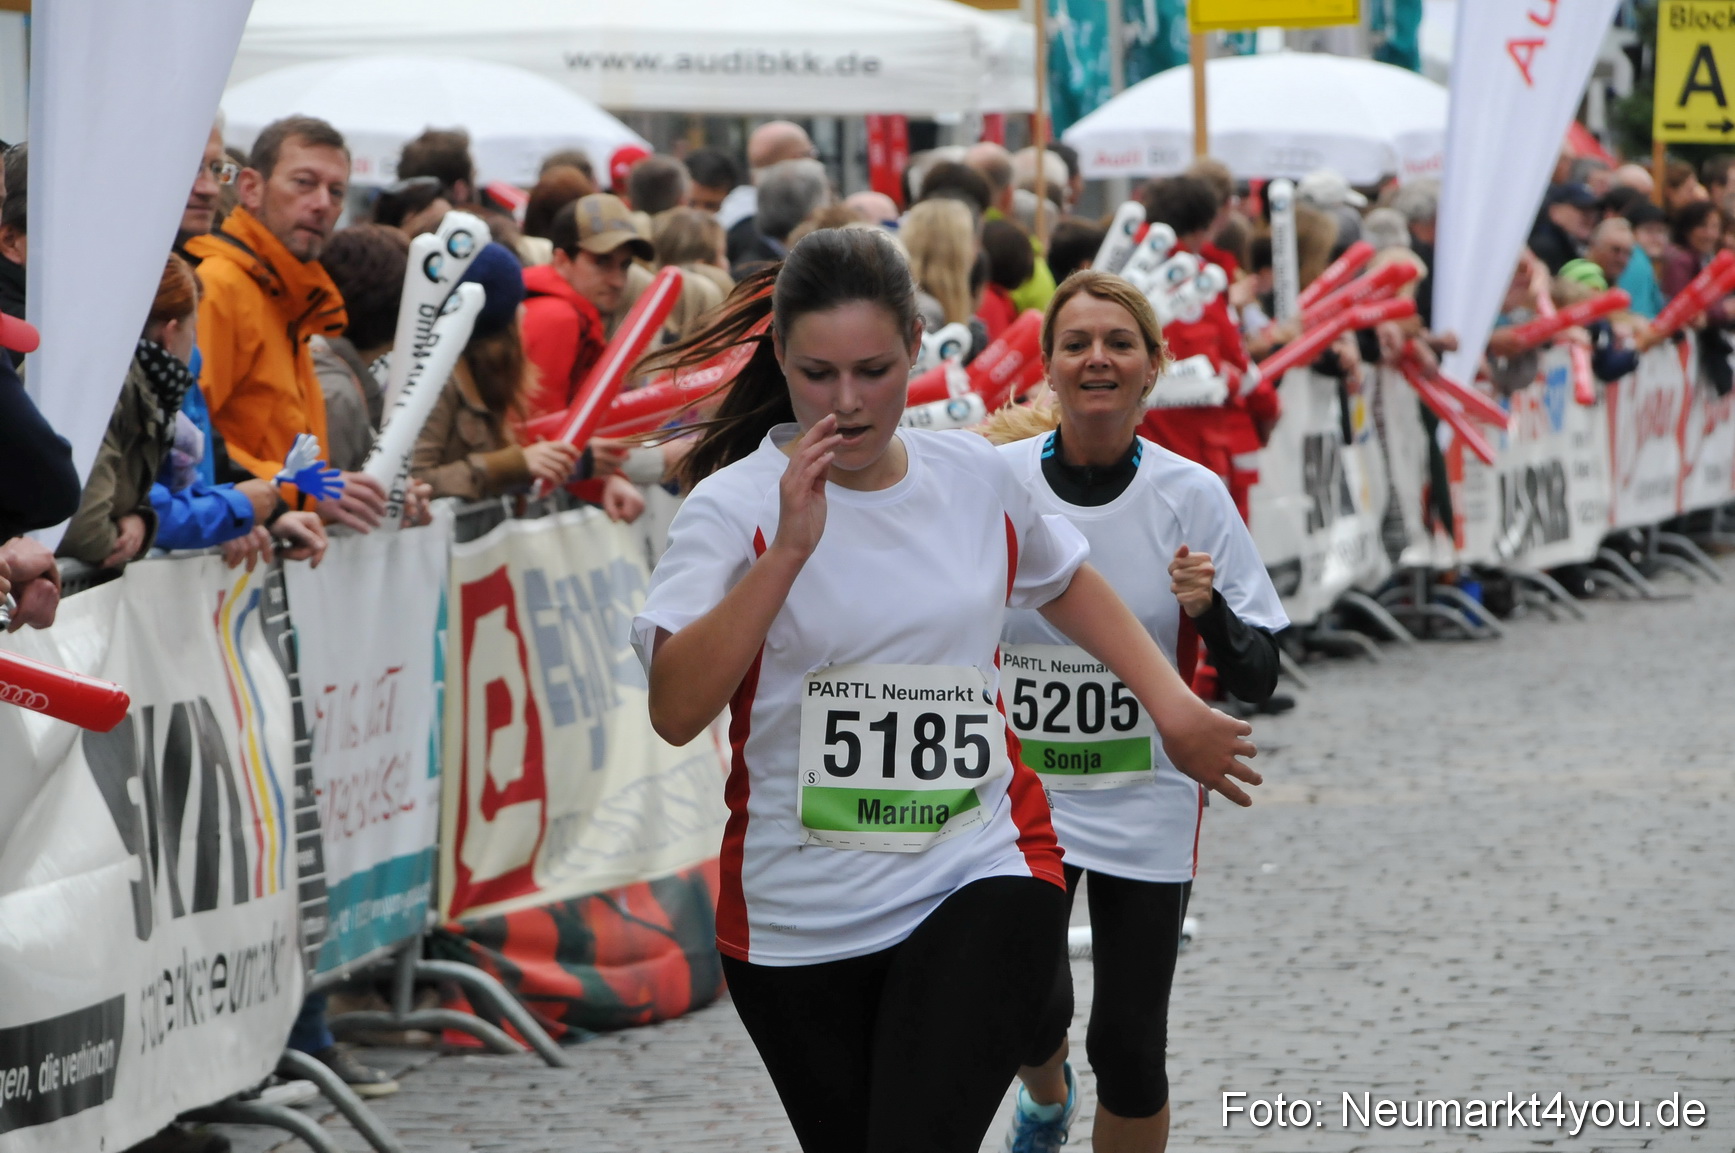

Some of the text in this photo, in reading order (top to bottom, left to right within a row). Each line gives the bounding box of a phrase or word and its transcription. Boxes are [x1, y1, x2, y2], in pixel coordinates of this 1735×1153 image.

[563, 48, 881, 78] www.audibkk.de
[1679, 43, 1727, 107] A
[1003, 653, 1047, 673] PARTL
[808, 681, 974, 702] PARTL Neumarkt
[1012, 677, 1139, 734] 5205
[823, 709, 991, 781] 5185
[1043, 748, 1102, 774] Sonja
[857, 797, 951, 825] Marina
[38, 1052, 60, 1094] die
